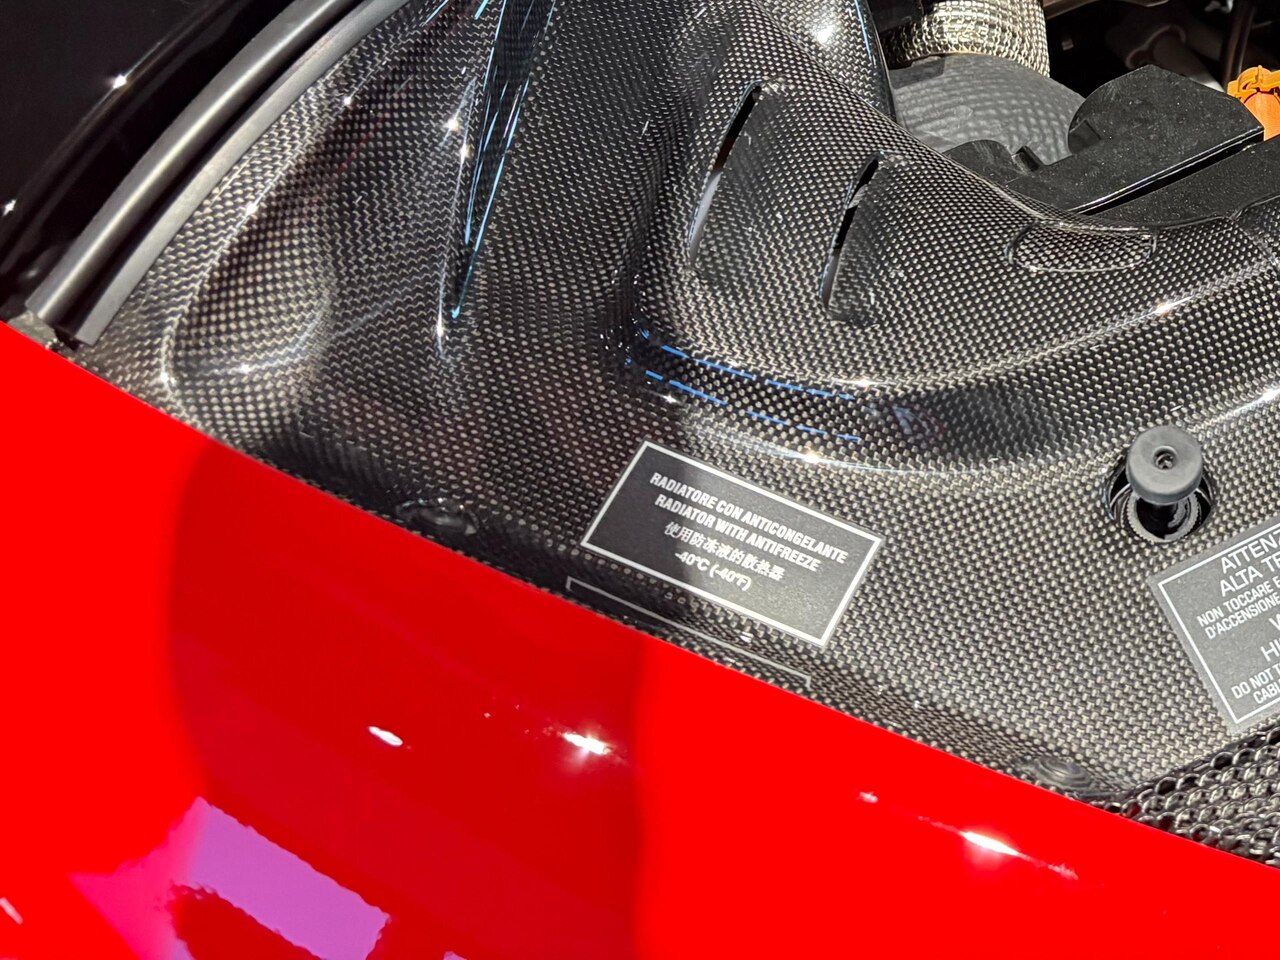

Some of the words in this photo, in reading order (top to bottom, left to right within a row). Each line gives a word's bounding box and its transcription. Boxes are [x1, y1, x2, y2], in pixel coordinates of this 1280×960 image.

[650, 473, 718, 509] RADIATORE
[716, 500, 744, 520] CON
[740, 511, 848, 564] ANTICONGELANTE
[655, 494, 717, 528] RADIATOR
[715, 518, 749, 542] WITH
[746, 533, 821, 572] ANTIFREEZE
[1197, 606, 1224, 627] NON
[1223, 581, 1274, 612] TOCCARE
[1220, 566, 1263, 597] ALTA
[1231, 681, 1251, 699] DO
[1249, 668, 1274, 689] NOT
